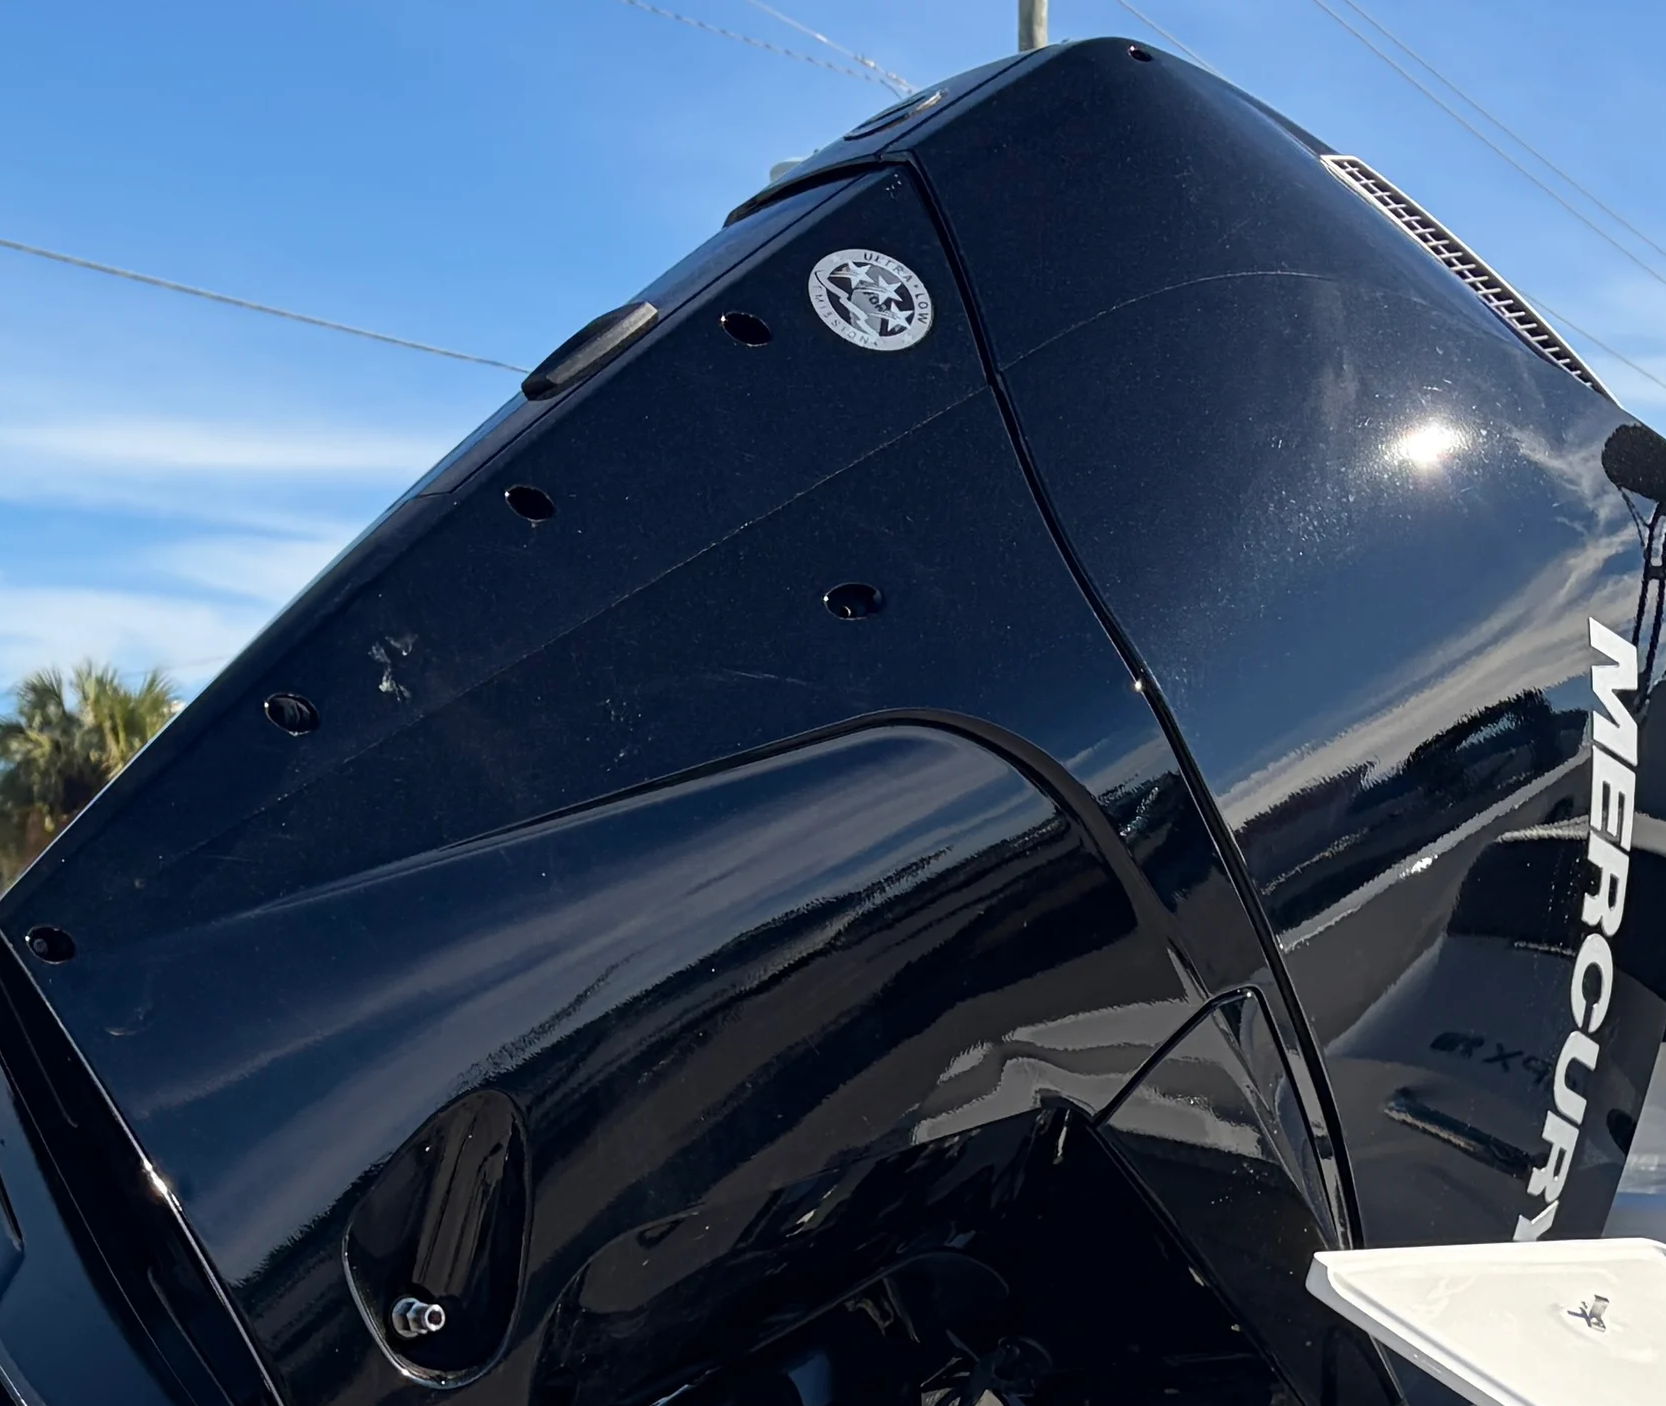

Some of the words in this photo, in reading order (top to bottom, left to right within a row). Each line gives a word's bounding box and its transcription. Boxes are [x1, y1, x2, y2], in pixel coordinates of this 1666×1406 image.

[863, 252, 913, 283] ULTRA
[915, 293, 929, 325] LOW
[1513, 616, 1639, 1242] MERCURY
